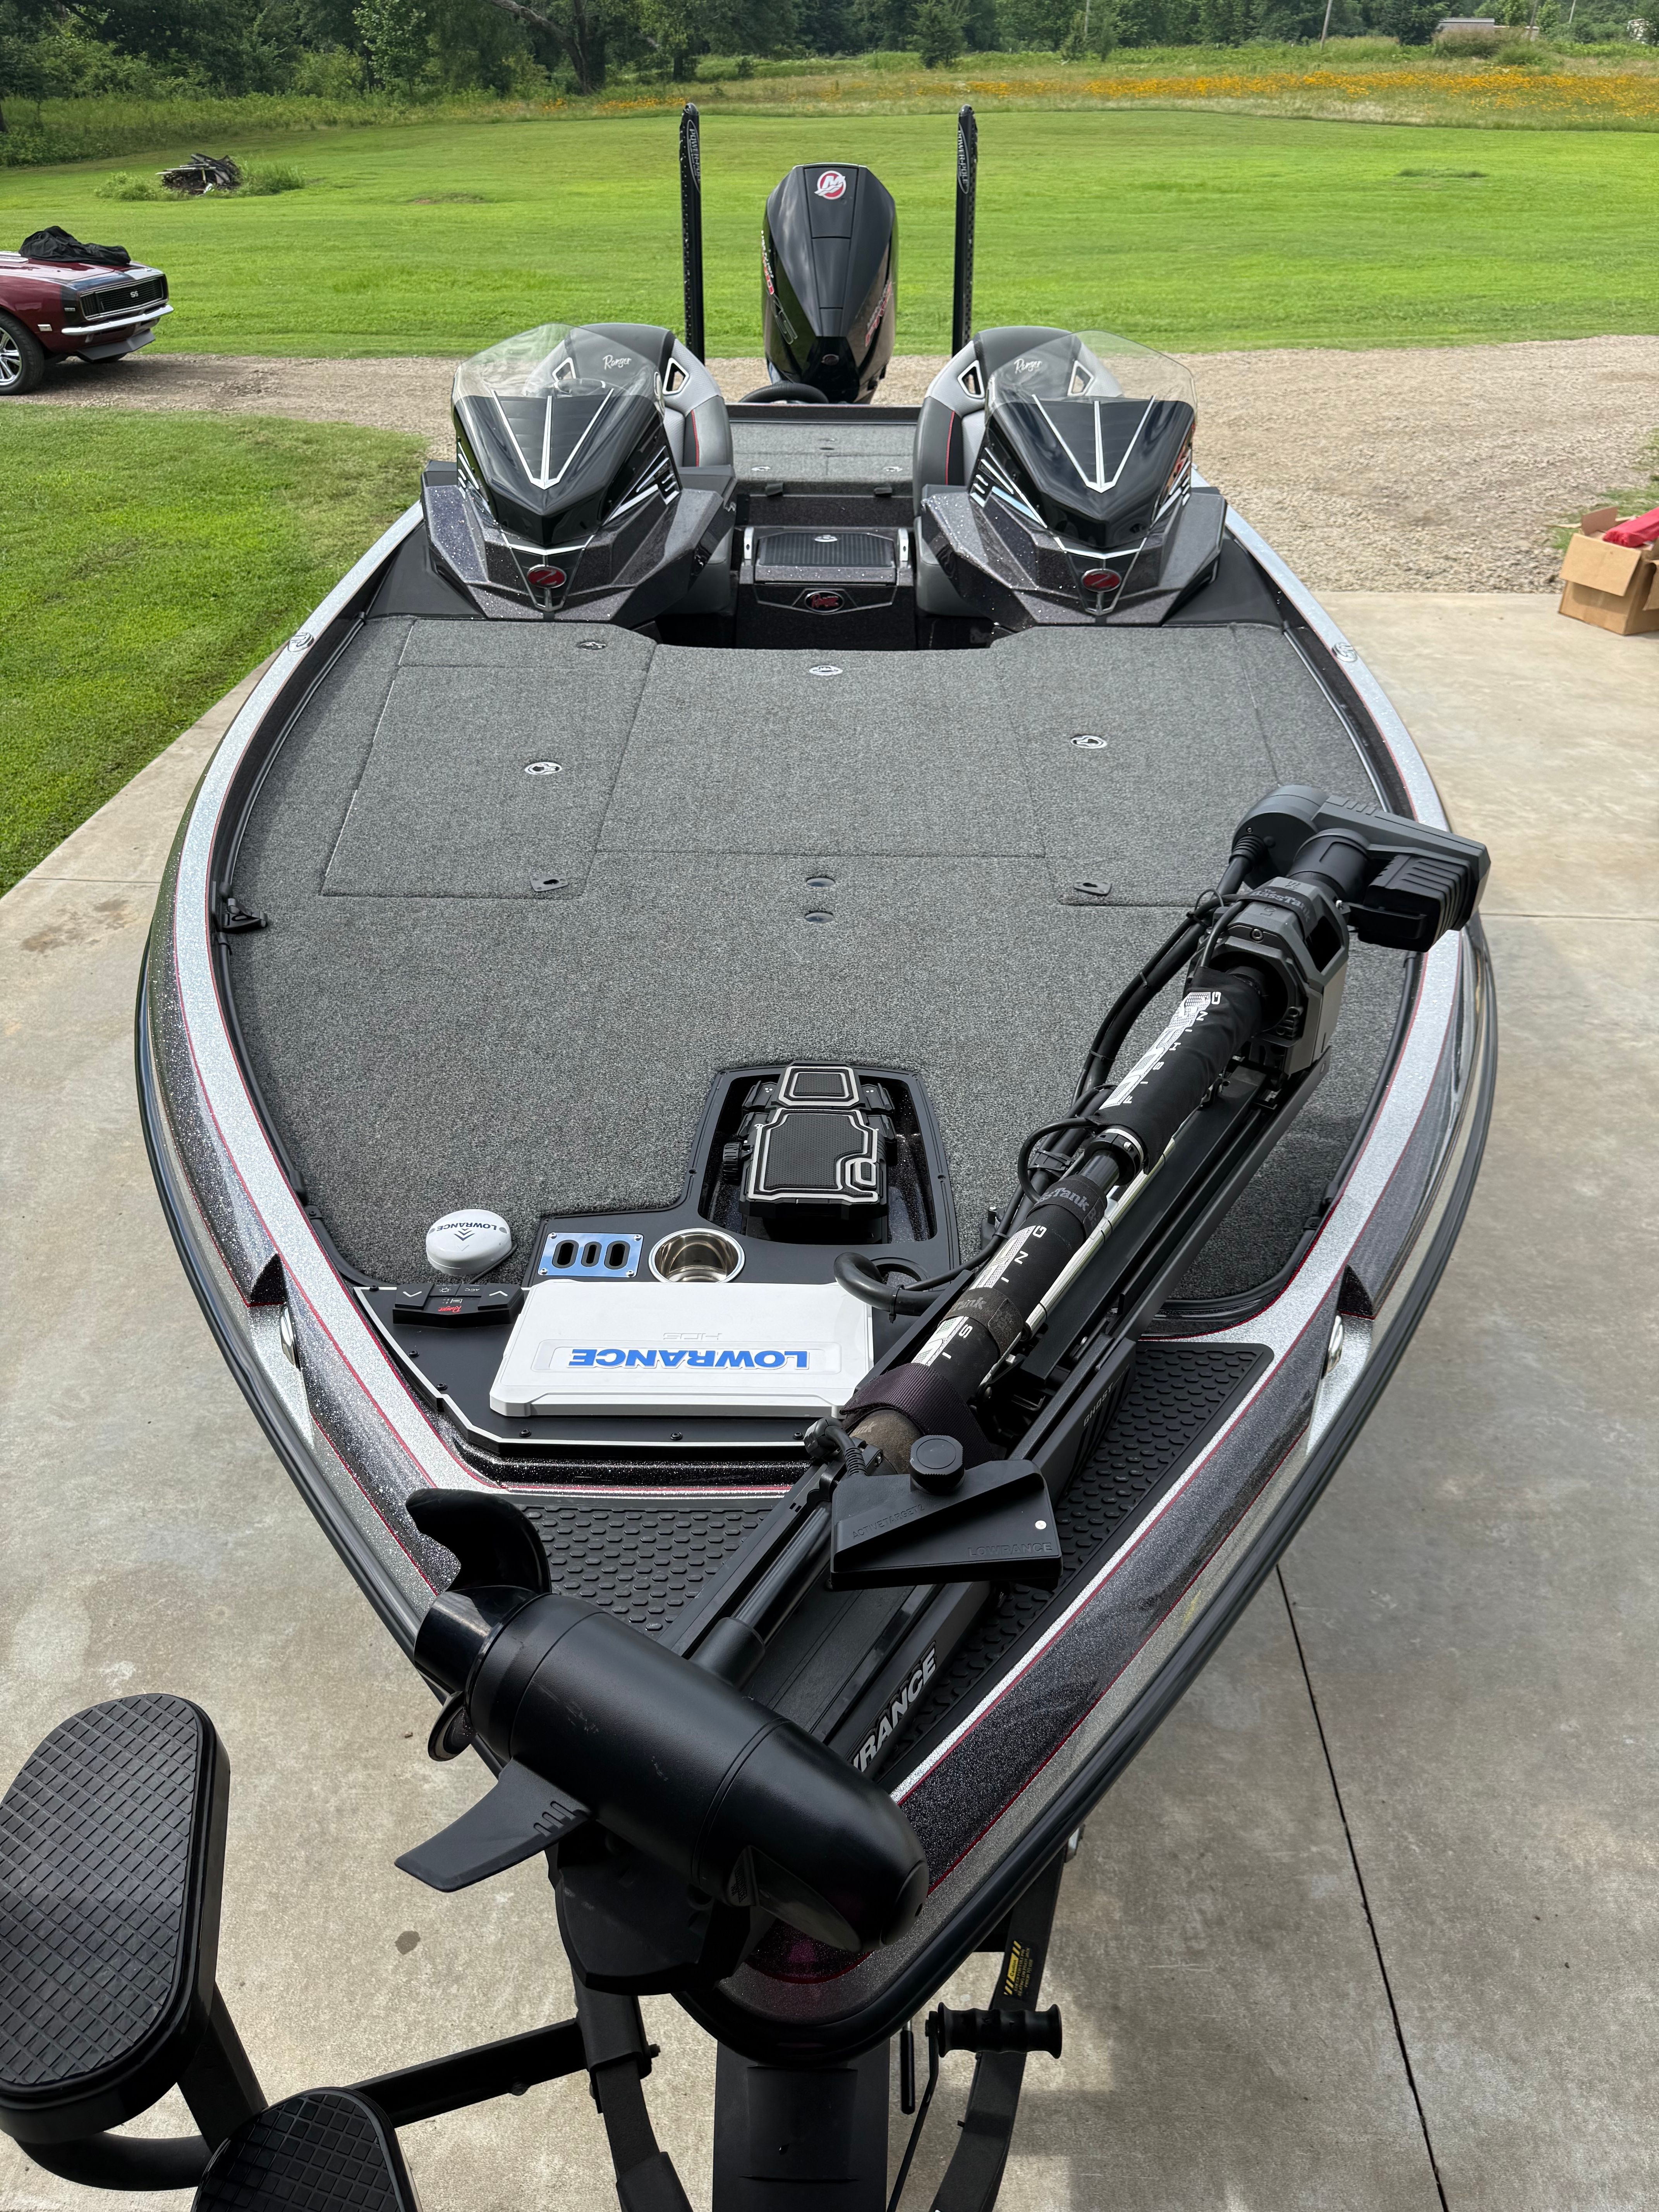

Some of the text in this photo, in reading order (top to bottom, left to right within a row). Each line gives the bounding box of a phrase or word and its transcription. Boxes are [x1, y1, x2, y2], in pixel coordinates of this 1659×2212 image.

[603, 355, 632, 370] Ranger
[1014, 359, 1042, 374] Ranger
[436, 1222, 497, 1231] LOWRANCE
[568, 1349, 809, 1369] LOWRANCE
[1084, 1381, 1113, 1427] GHOST
[969, 1542, 1053, 1557] LOWRANCE
